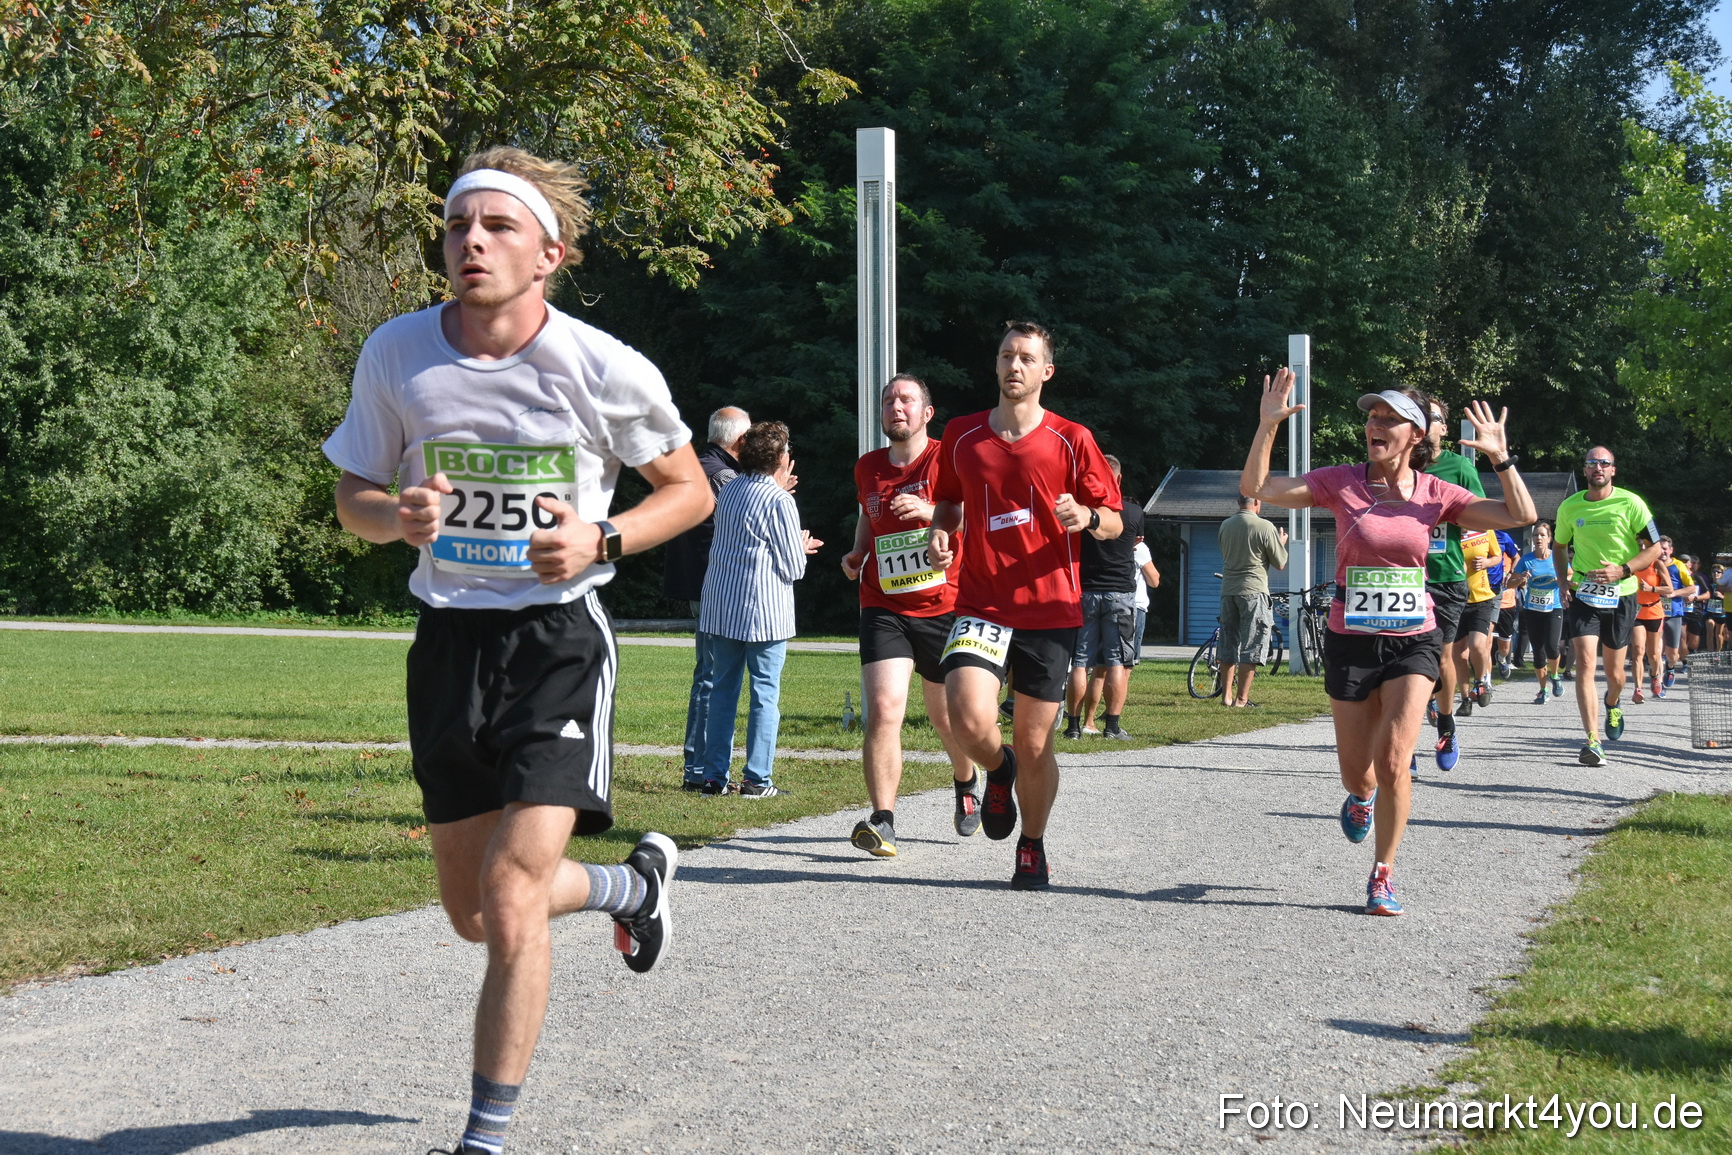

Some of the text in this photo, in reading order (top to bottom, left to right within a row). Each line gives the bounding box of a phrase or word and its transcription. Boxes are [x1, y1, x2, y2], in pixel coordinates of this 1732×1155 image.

[435, 447, 565, 479] BOCK
[444, 488, 559, 531] 2250
[1000, 514, 1019, 526] DEHN
[452, 542, 531, 562] THOMA
[891, 572, 934, 587] MARKUS
[1353, 570, 1419, 585] BOCK
[1581, 583, 1615, 598] 2235
[1355, 592, 1416, 612] 2129
[1531, 595, 1551, 605] 2367
[1579, 596, 1614, 605] CHRISTIAN
[1363, 618, 1407, 627] JUDITH
[952, 620, 1002, 643] 1313
